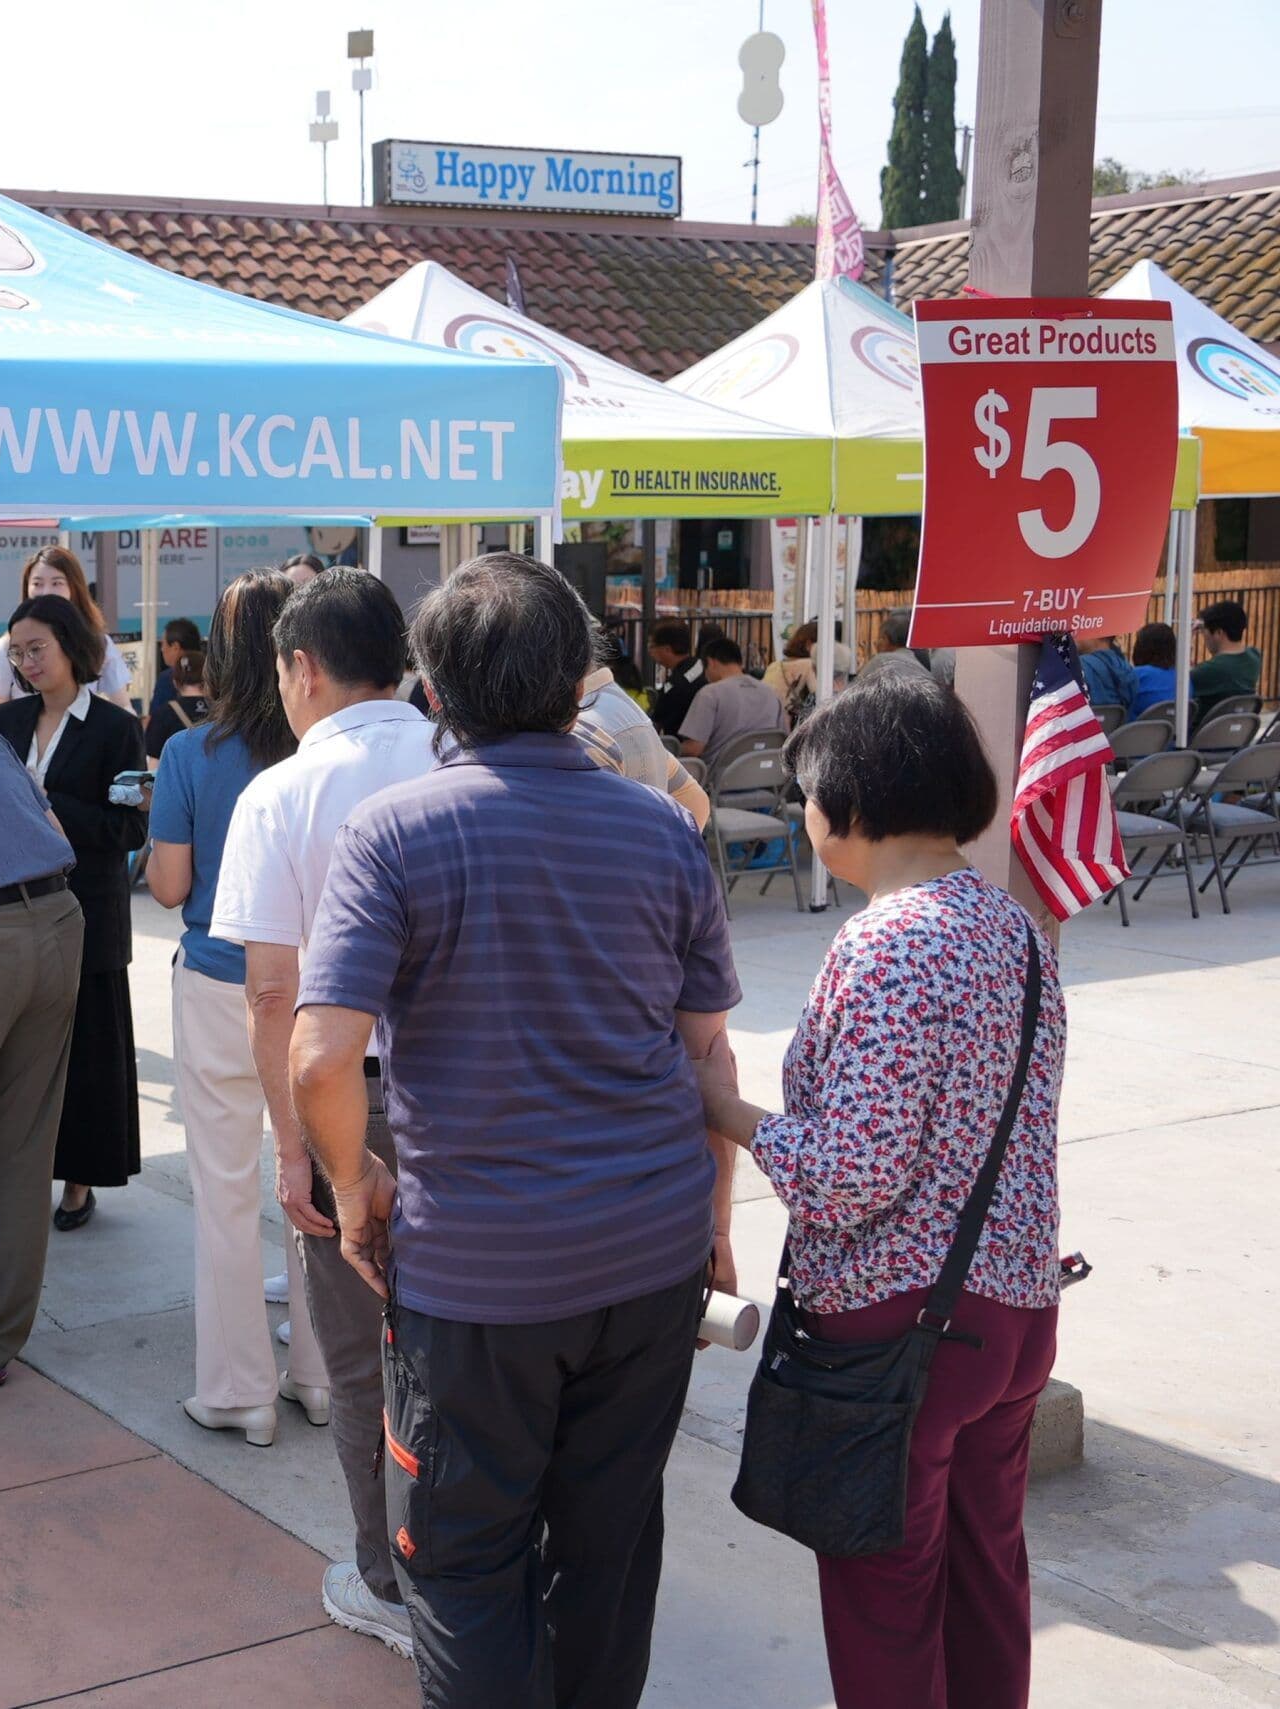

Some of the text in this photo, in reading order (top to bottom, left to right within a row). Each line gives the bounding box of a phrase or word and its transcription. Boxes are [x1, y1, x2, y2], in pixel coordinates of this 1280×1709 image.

[435, 151, 675, 209] Happy Morning
[948, 325, 1157, 356] Great Products
[611, 469, 630, 490] TO
[635, 470, 691, 490] HEALTH
[695, 471, 782, 492] INSURANCE.
[973, 386, 1101, 559] $5
[81, 528, 208, 550] MDIARE
[1022, 587, 1084, 612] 7-BUY
[989, 614, 1103, 638] Liquidation Store
